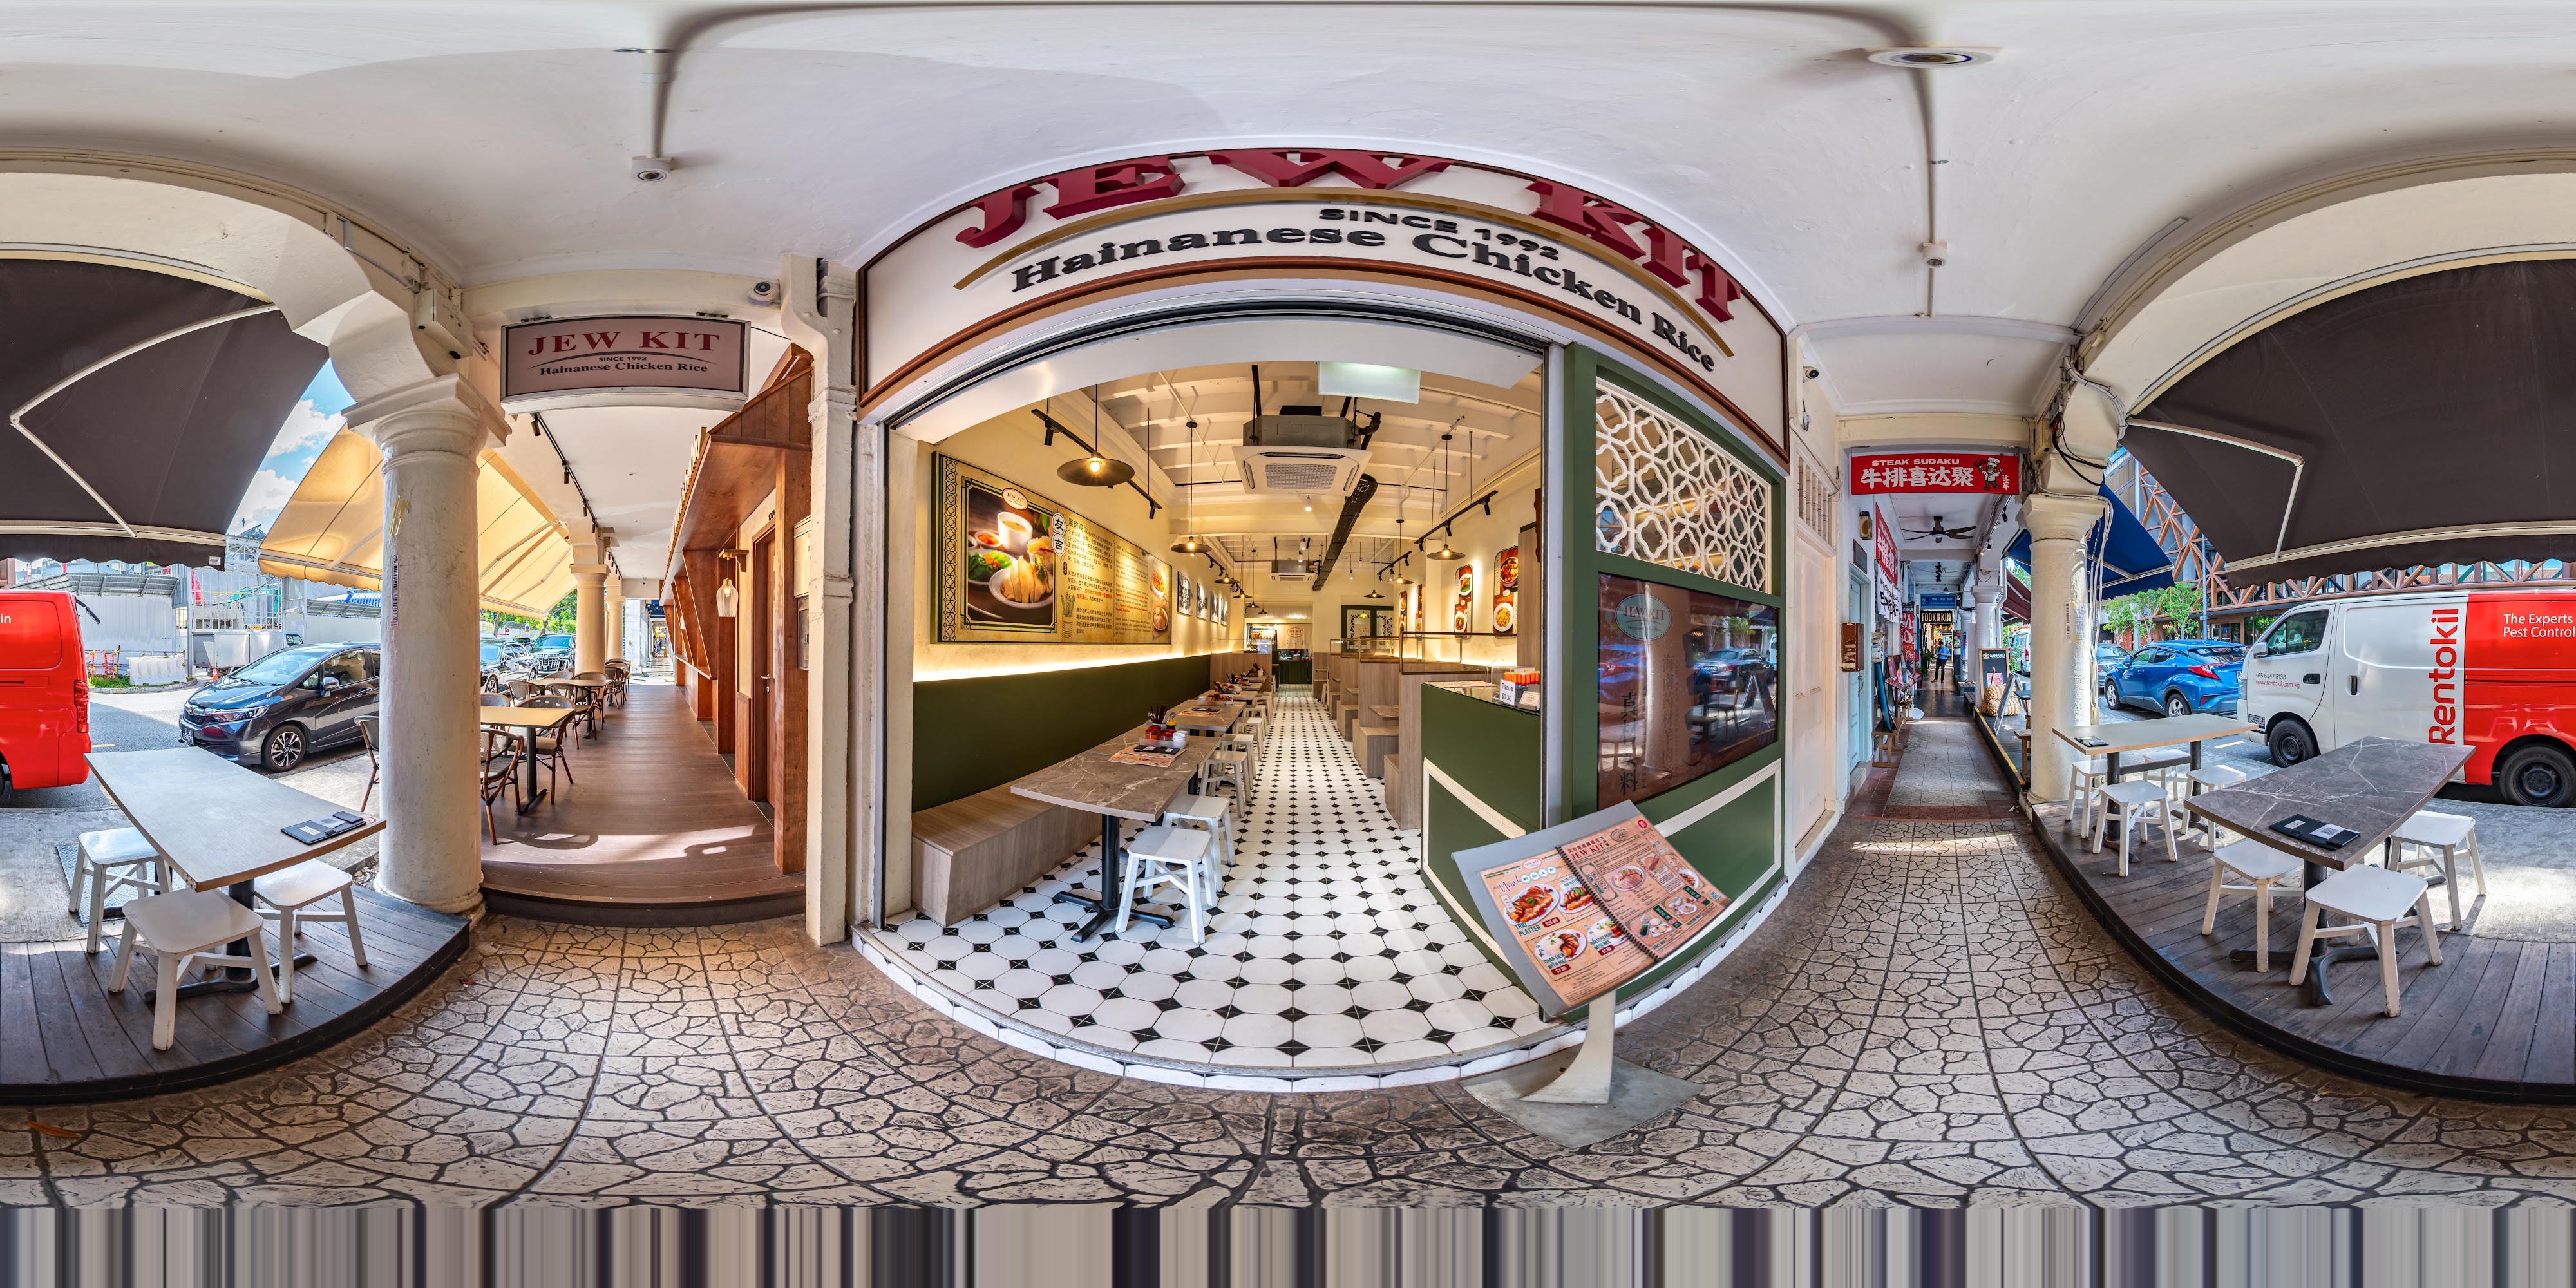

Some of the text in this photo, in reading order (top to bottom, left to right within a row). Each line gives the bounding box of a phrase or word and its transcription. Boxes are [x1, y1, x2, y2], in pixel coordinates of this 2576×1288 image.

[955, 147, 1741, 323] JEW KIT
[1319, 207, 1559, 261] SINCE 1992
[1012, 227, 1716, 372] Hainanese Chicken Rice
[528, 330, 721, 355] JEW KIT
[540, 361, 708, 377] Hainanese Chicken Rice
[1861, 466, 1975, 489] 牛排喜达聚
[1054, 518, 1063, 550] 友吉
[1, 613, 11, 624] in
[1623, 605, 1666, 620] JEW KIT
[1921, 612, 1936, 621] FOOK
[1940, 612, 1951, 621] KIN
[2503, 613, 2573, 627] The Experts
[2503, 626, 2575, 638] Pest Control
[2255, 679, 2300, 689] www.rentokil.com.sg
[2429, 609, 2459, 744] Rentokil
[1502, 683, 1513, 692] Tissue
[1502, 693, 1512, 701] $0.30
[1571, 842, 1604, 860] JEW KIT
[1498, 875, 1522, 893] New!
[1518, 925, 1542, 936] PLATTER
[1543, 955, 1556, 964] CHAR
[1547, 960, 1559, 969] WITH
